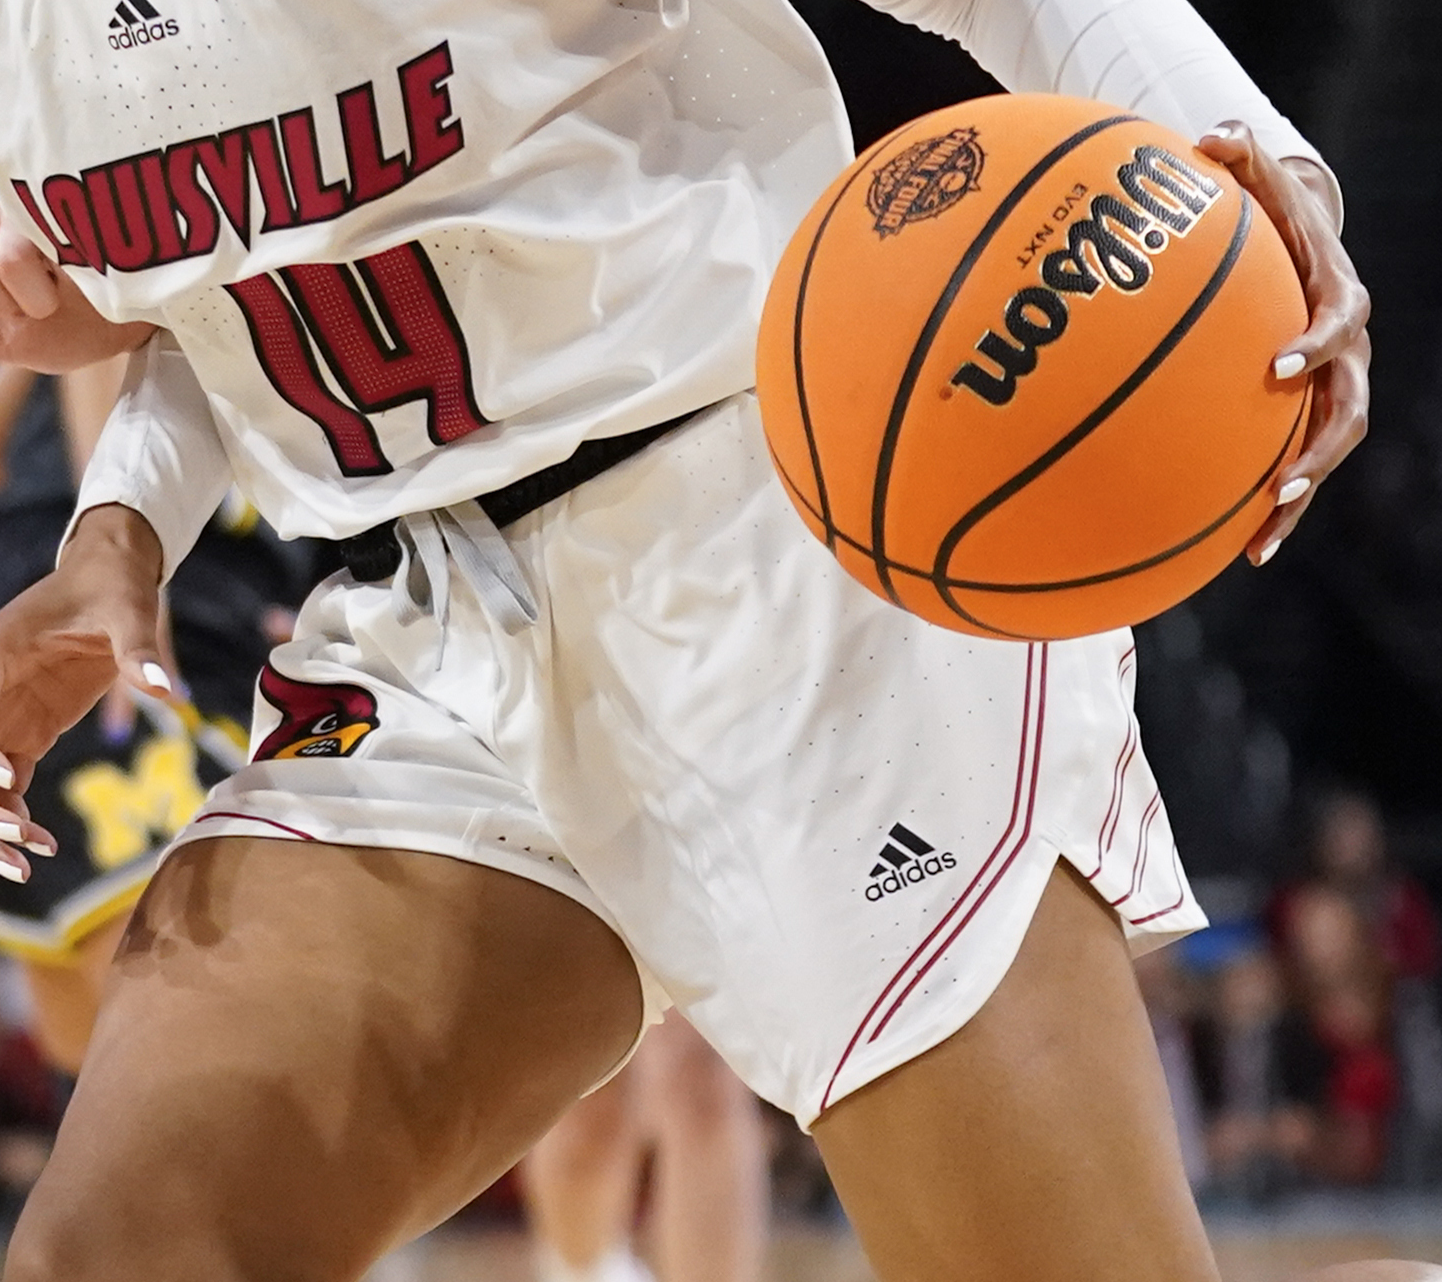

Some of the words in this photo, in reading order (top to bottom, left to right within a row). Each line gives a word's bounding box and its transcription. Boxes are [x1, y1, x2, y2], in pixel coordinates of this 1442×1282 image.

[107, 17, 181, 51] adidas
[10, 39, 465, 275] LOUISVILLE
[1052, 182, 1089, 221] EVO
[948, 144, 1224, 406] Wilson
[1015, 222, 1055, 269] NXT
[222, 239, 496, 478] 14
[63, 736, 208, 871] M
[864, 846, 958, 902] adidas
